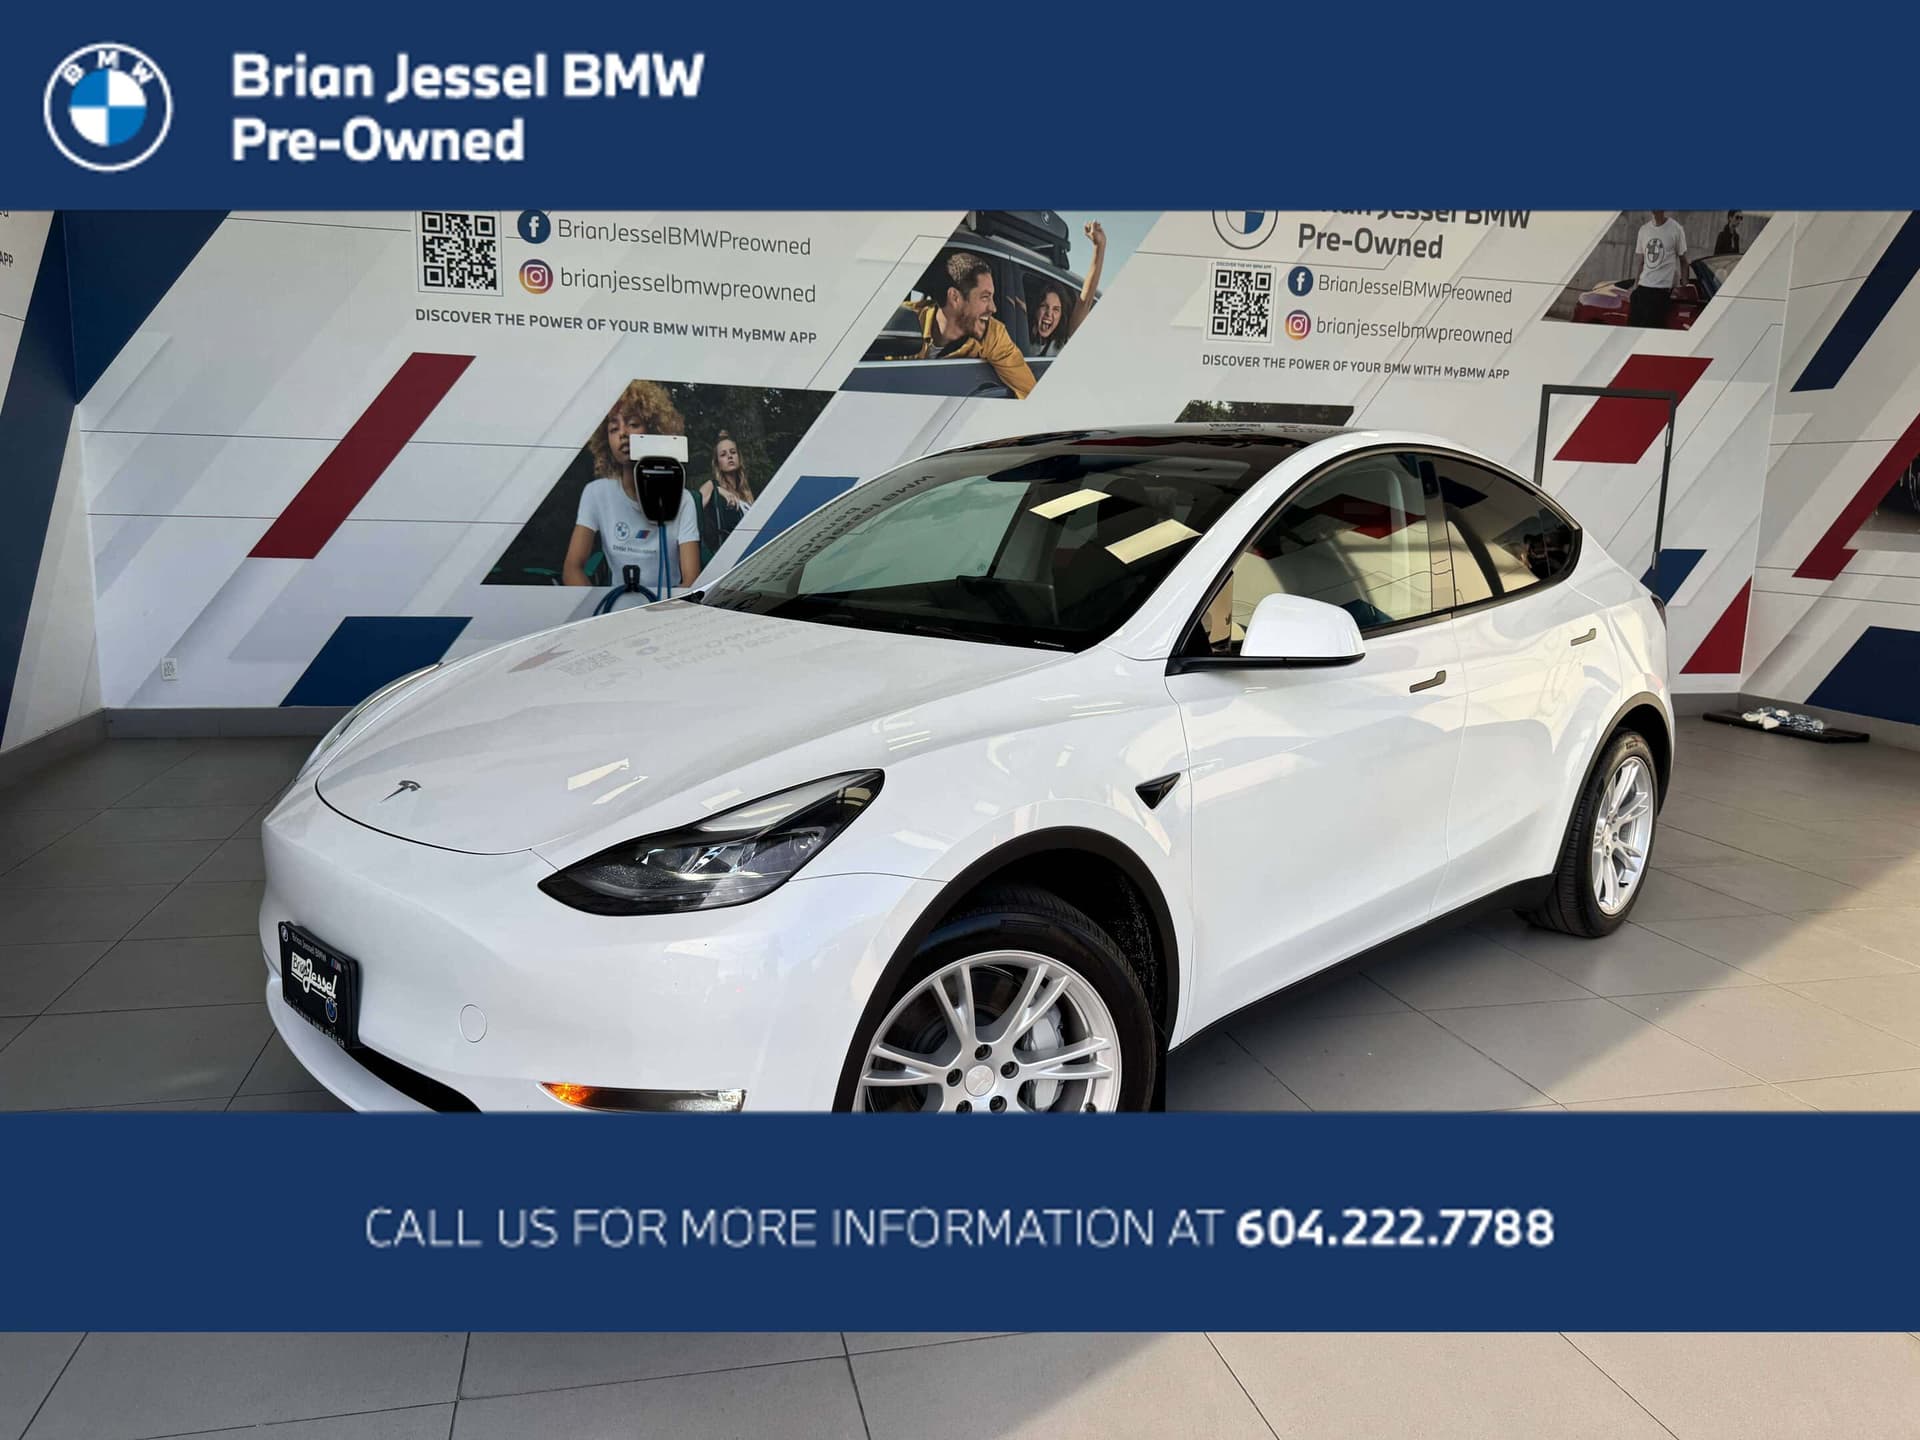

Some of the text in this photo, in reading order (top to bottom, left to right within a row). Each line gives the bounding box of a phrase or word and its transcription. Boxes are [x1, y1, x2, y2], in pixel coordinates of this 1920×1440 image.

[558, 219, 812, 256] BrianJesselBMWPreowned
[1298, 223, 1444, 259] Pre-Owned
[560, 267, 817, 303] brianjesselbmwpreowned
[1318, 274, 1513, 304] BrianJesselBMWPreowned
[416, 308, 817, 344] DISCOVER THE POWER OF YOUR BMW WITH MyBMW APP
[1316, 316, 1513, 345] brianjesselbmwpreowned
[1202, 354, 1510, 380] DISCOVER THE POWER OF YOUR BMW WITH MyBMW APP
